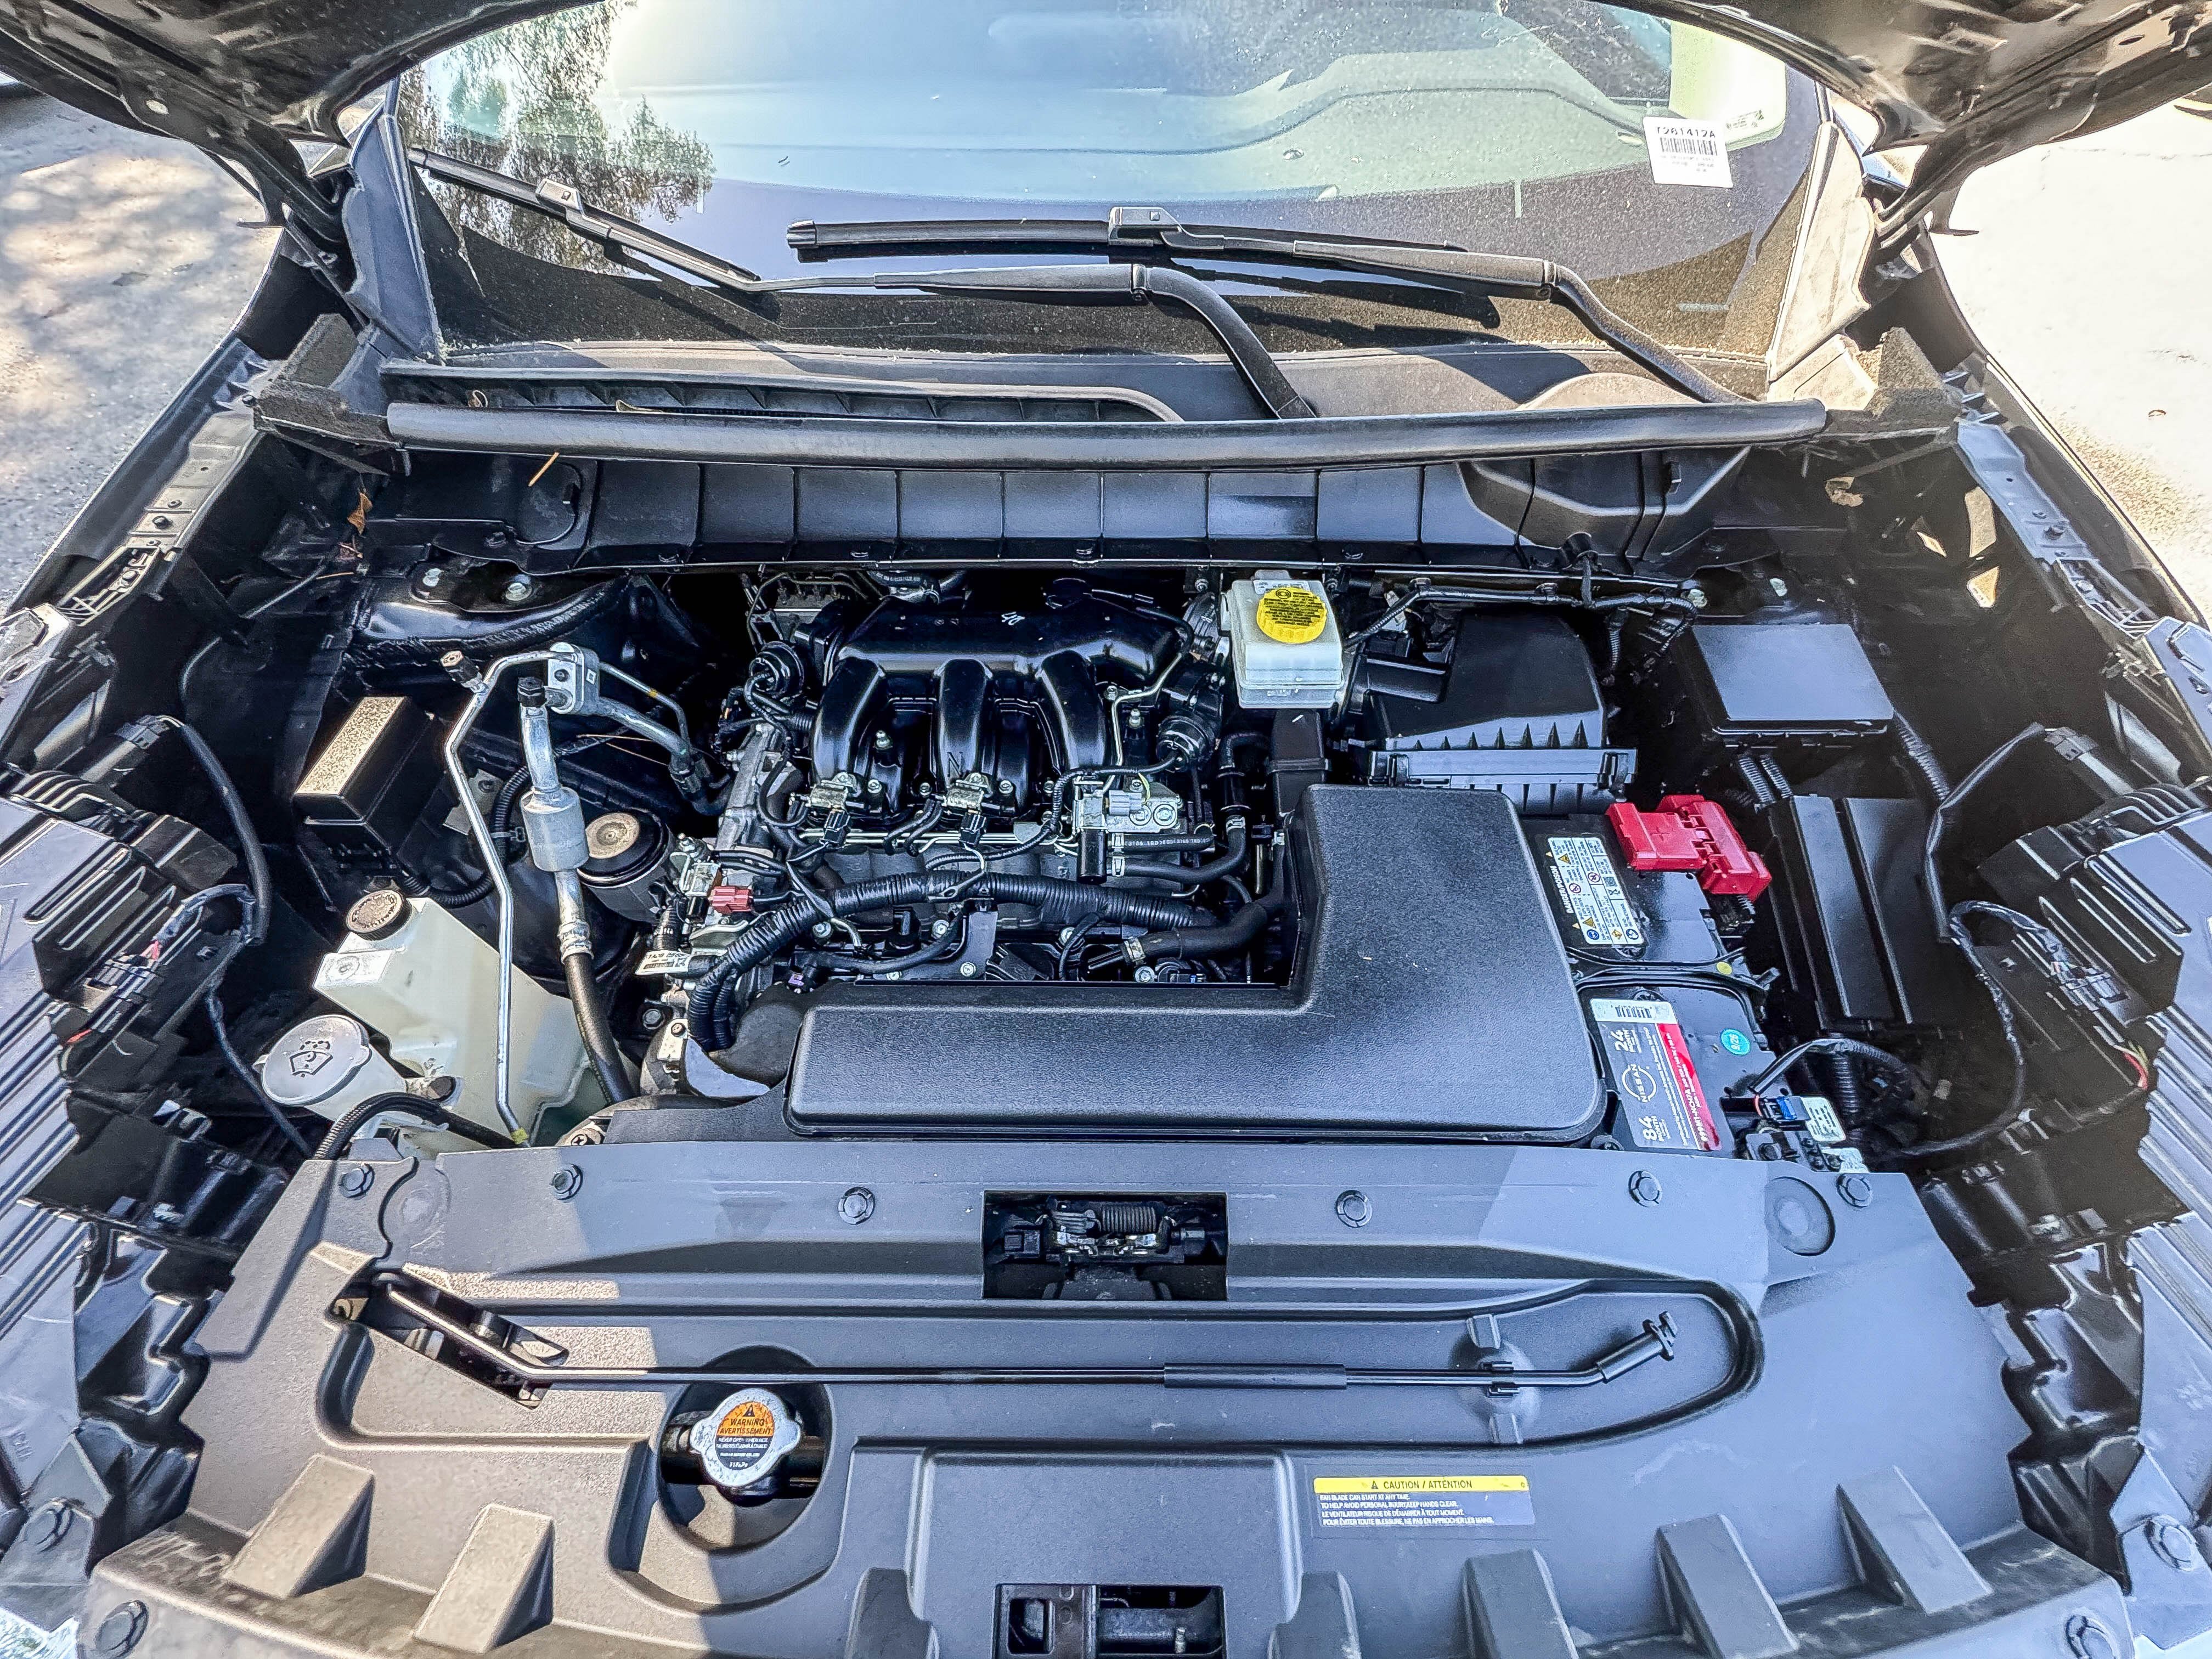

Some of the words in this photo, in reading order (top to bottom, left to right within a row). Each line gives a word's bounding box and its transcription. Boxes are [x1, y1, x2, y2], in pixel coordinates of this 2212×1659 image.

[1610, 1030, 1629, 1051] 24
[1622, 1029, 1635, 1052] MONTH
[1630, 1063, 1648, 1102] NISSAN
[1638, 1116, 1656, 1139] 84
[1651, 1115, 1664, 1141] MONTH
[1384, 1481, 1419, 1489] CAUTION
[1429, 1480, 1472, 1488] ATTENTION
